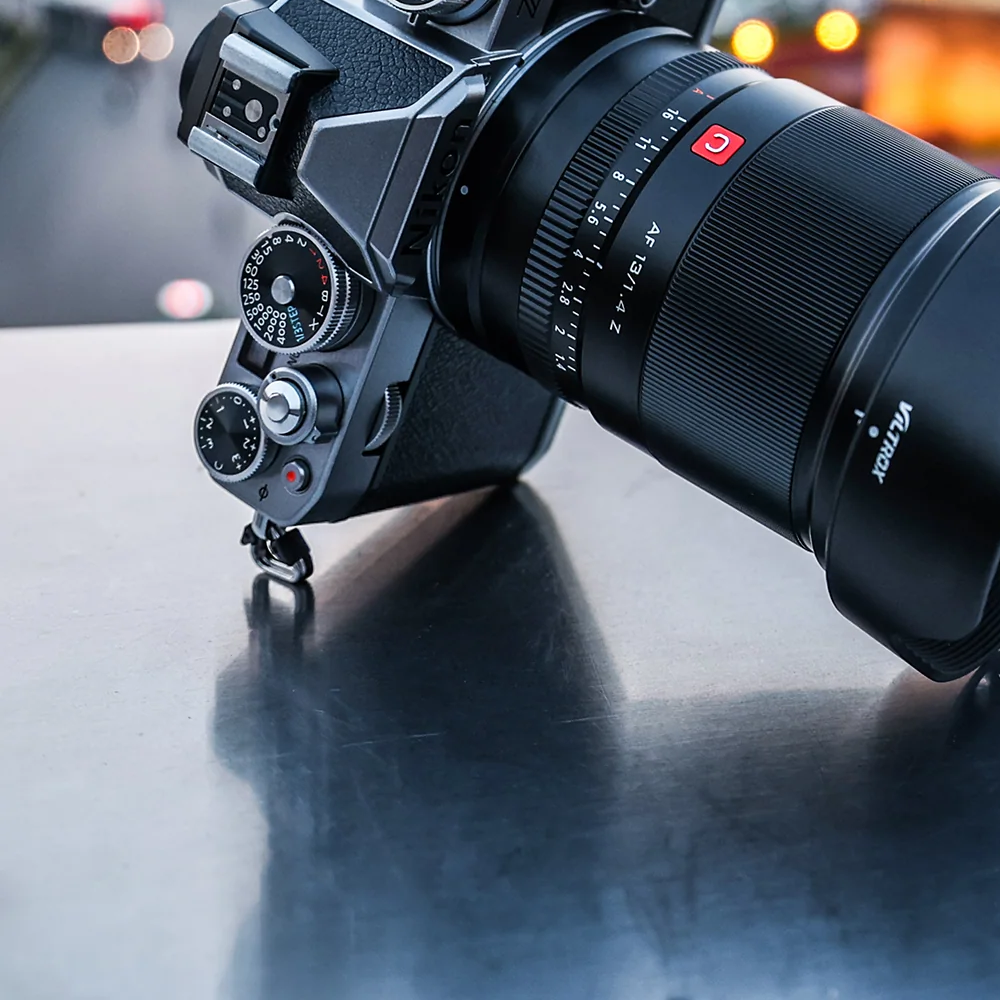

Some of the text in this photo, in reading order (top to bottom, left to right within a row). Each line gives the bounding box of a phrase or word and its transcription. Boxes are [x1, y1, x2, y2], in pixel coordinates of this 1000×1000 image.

[662, 108, 679, 120] 16
[635, 136, 652, 150] 11
[612, 170, 624, 181] 8
[587, 201, 606, 226] 5.6
[272, 236, 282, 246] 8
[285, 234, 294, 244] 4
[297, 238, 307, 248] 2
[260, 240, 272, 256] 15
[572, 248, 584, 258] 4
[251, 249, 264, 266] 30
[245, 262, 258, 277] 60
[243, 278, 258, 290] 125
[610, 221, 660, 334] AF 13/1.4 Z
[242, 292, 260, 306] 250
[559, 281, 574, 306] 2.8
[246, 303, 264, 320] 500
[254, 306, 273, 330] 1000
[264, 310, 280, 342] 2000
[276, 312, 287, 345] 4000
[554, 324, 566, 336] 2
[554, 353, 566, 372] 1.4
[871, 400, 914, 484] VILTROX
